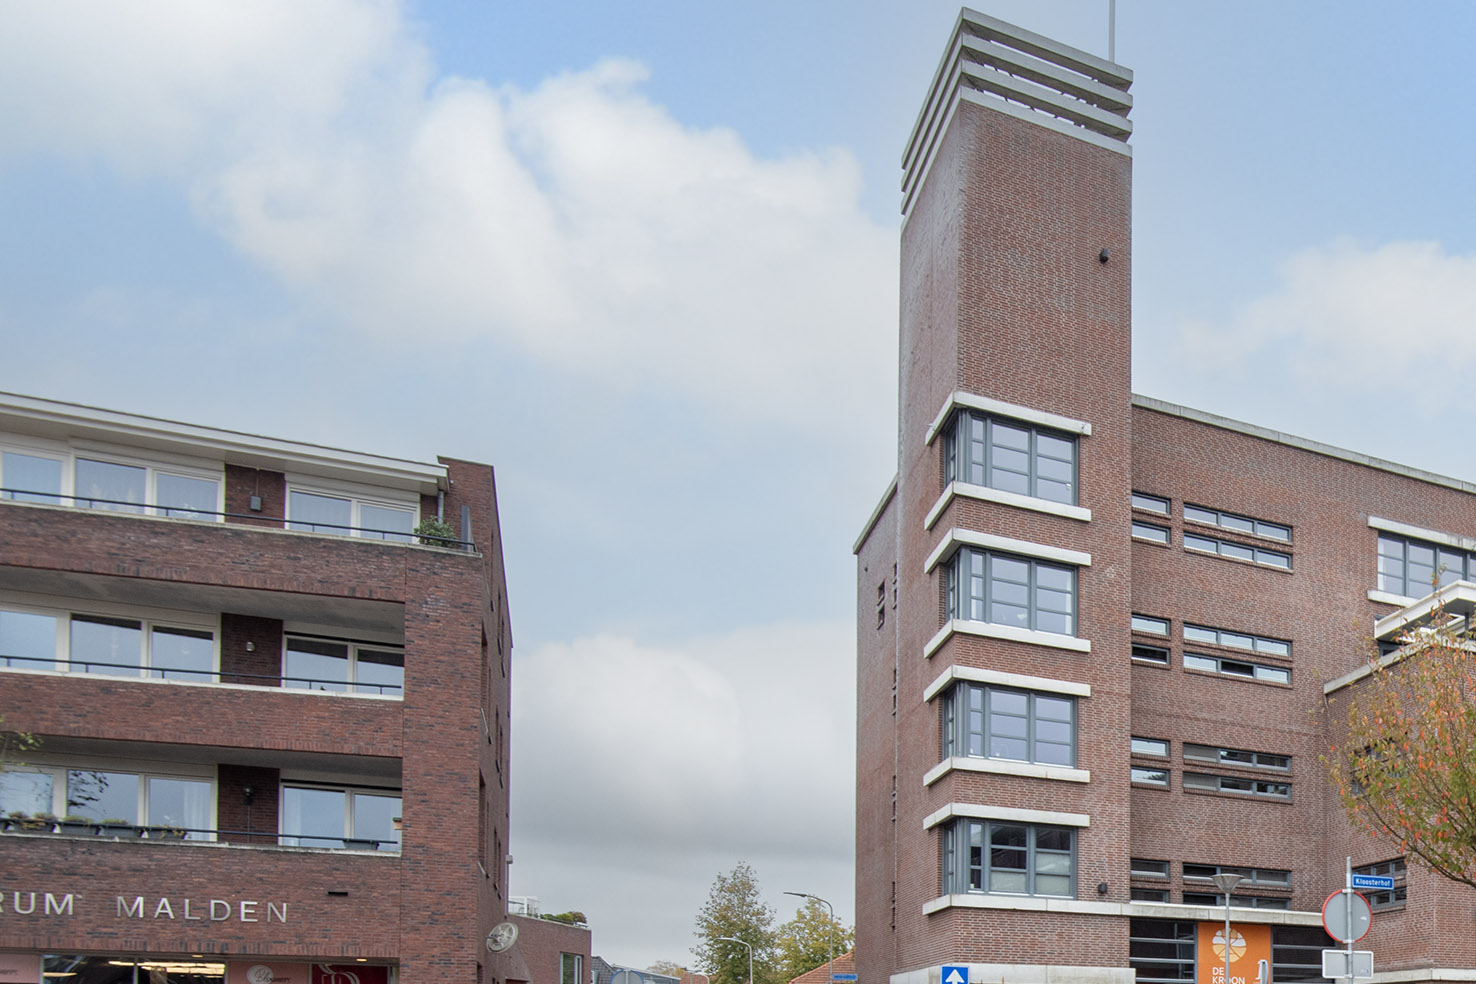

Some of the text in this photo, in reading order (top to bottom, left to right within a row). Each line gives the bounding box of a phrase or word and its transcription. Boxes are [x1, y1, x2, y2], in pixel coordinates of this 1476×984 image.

[1355, 877, 1391, 887] Kloosterhof
[0, 891, 288, 923] UM MALDEN
[1212, 966, 1225, 976] DE
[1212, 976, 1245, 984] KRON
